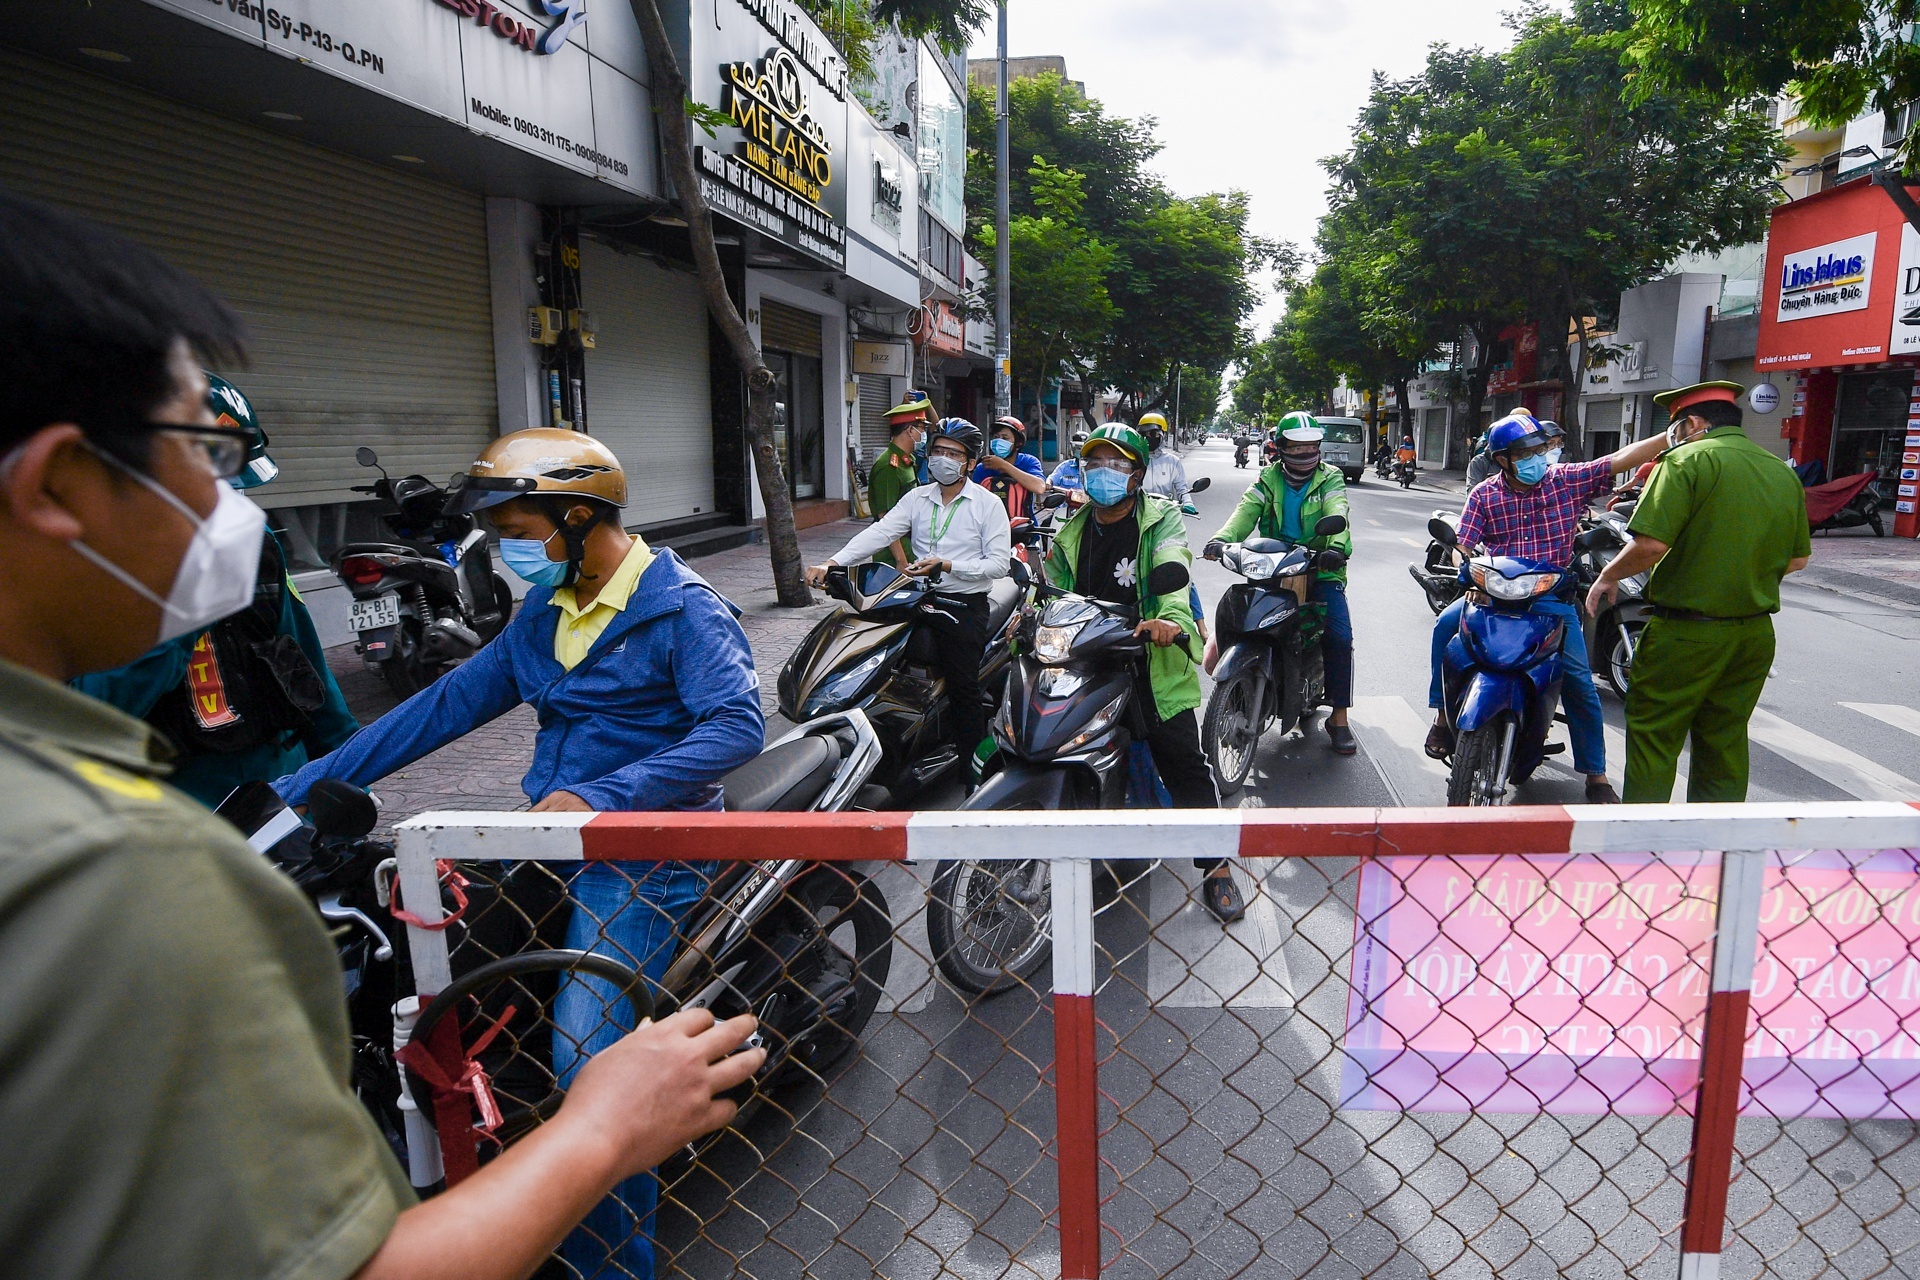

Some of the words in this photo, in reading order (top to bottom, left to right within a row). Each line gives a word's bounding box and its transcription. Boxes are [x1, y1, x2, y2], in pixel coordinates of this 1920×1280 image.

[471, 97, 512, 128] Mobile:
[731, 84, 832, 187] MELANO
[349, 612, 396, 630] 121.55
